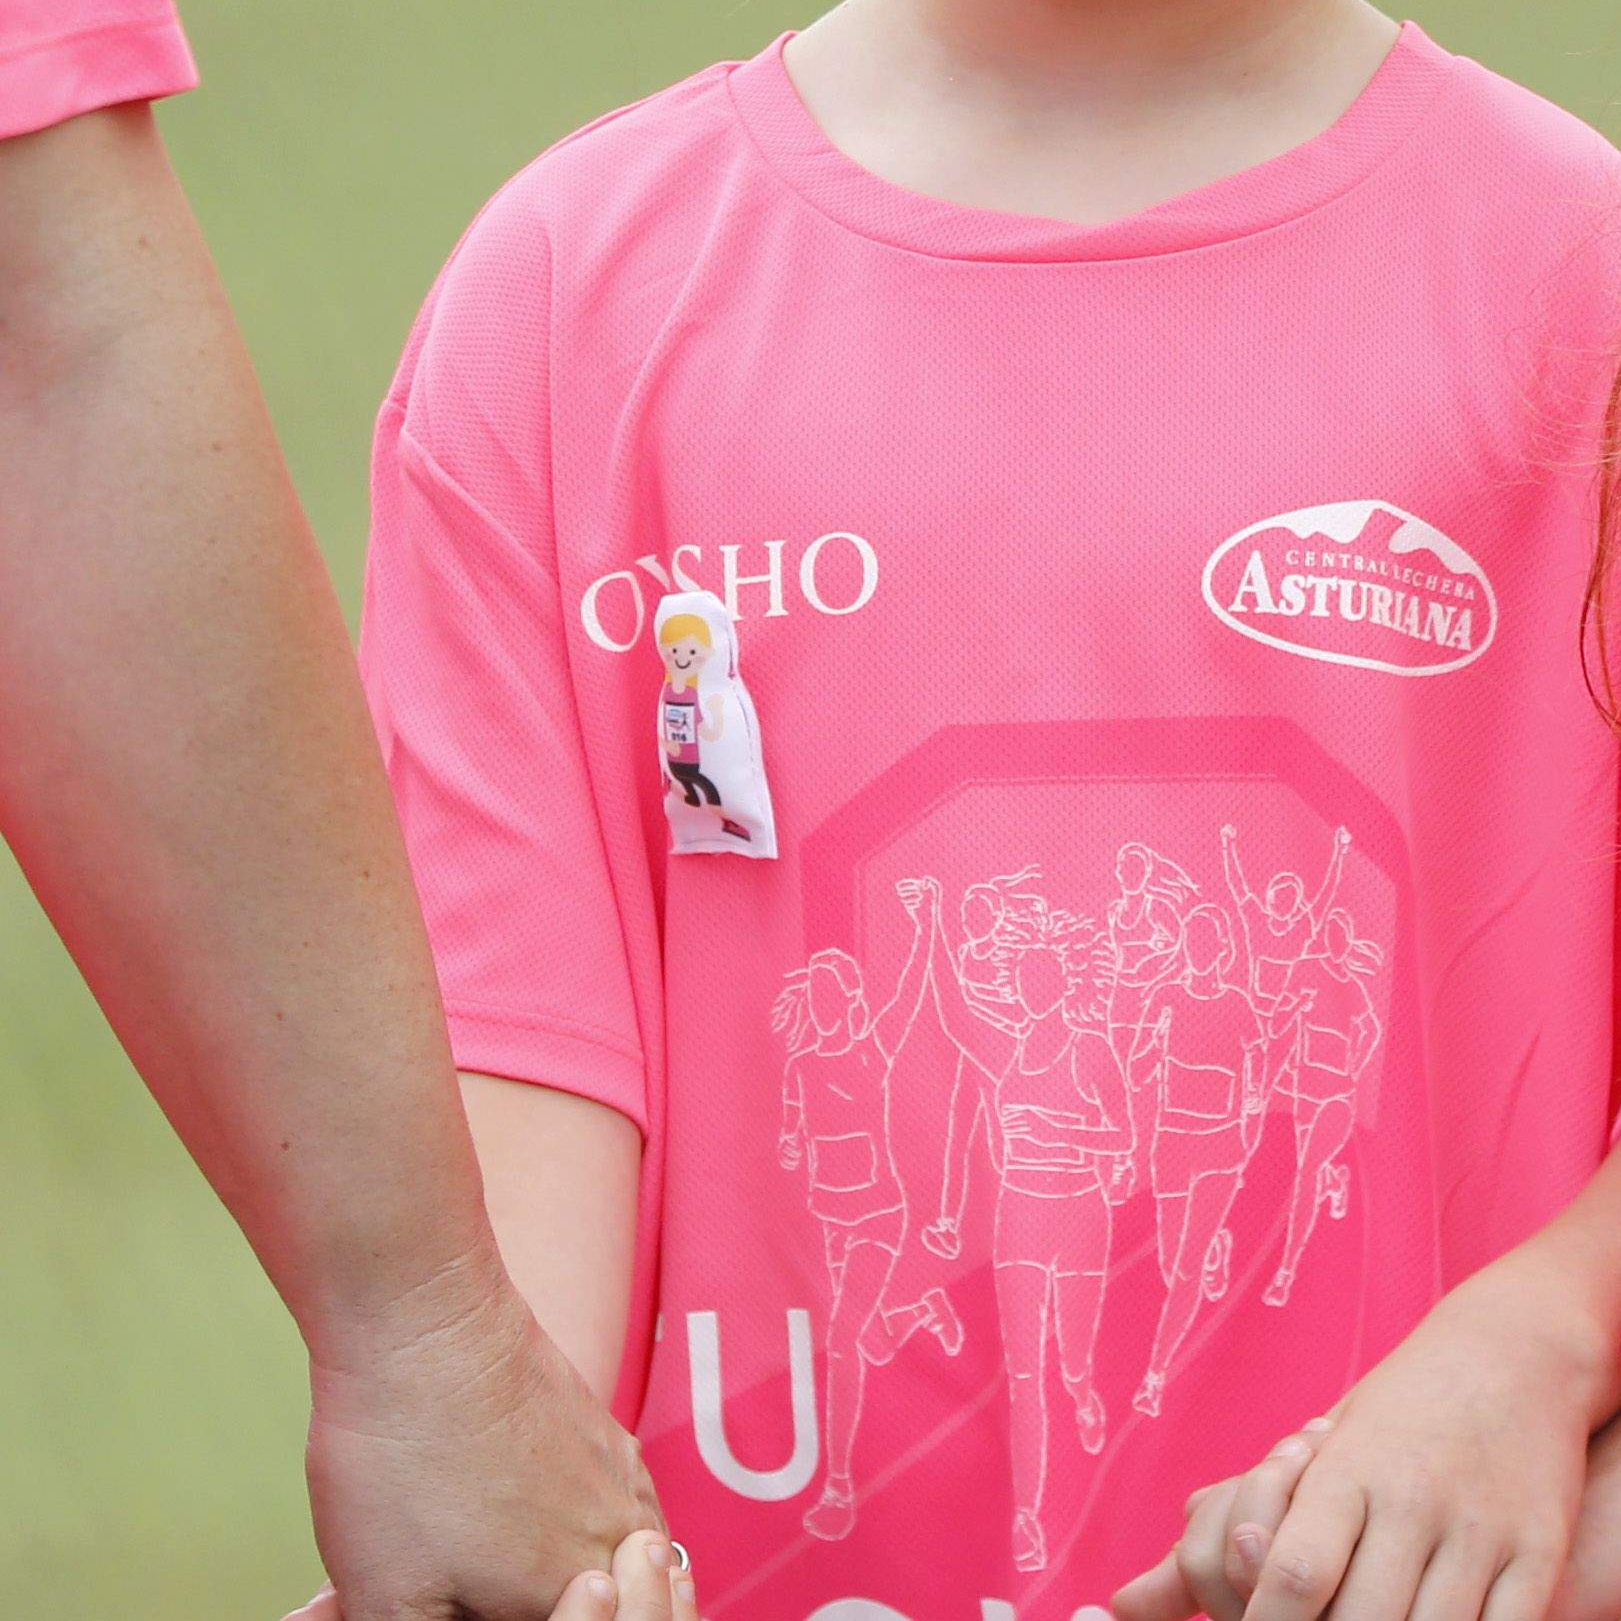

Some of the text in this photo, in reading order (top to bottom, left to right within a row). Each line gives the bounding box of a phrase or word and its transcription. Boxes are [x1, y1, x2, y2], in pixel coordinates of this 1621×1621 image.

[1228, 549, 1472, 652] ASTURIANA
[1285, 550, 1475, 600] CENTRAL LECHERA
